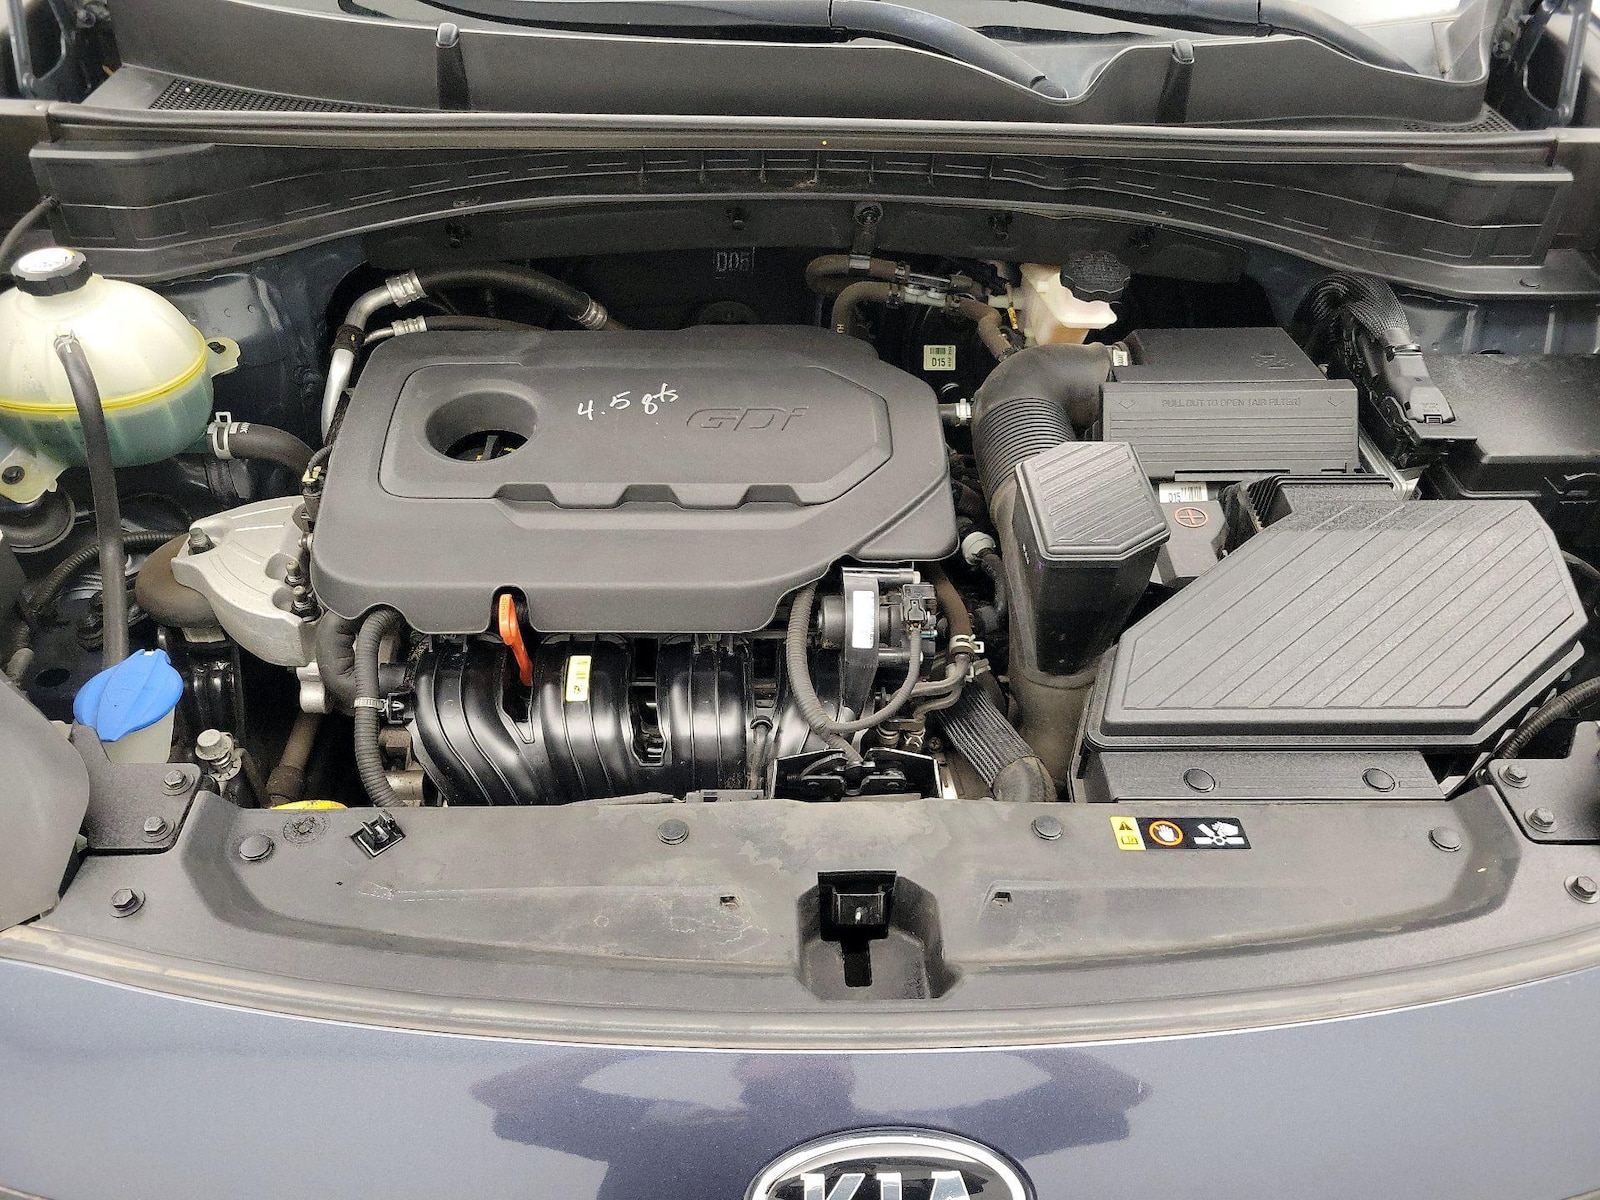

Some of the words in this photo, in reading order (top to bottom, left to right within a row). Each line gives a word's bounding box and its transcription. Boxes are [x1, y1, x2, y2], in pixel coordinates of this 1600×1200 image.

[577, 391, 631, 421] 4.5
[1206, 399, 1218, 407] TO
[1220, 398, 1245, 407] OPEN
[800, 1170, 971, 1200] KIA
